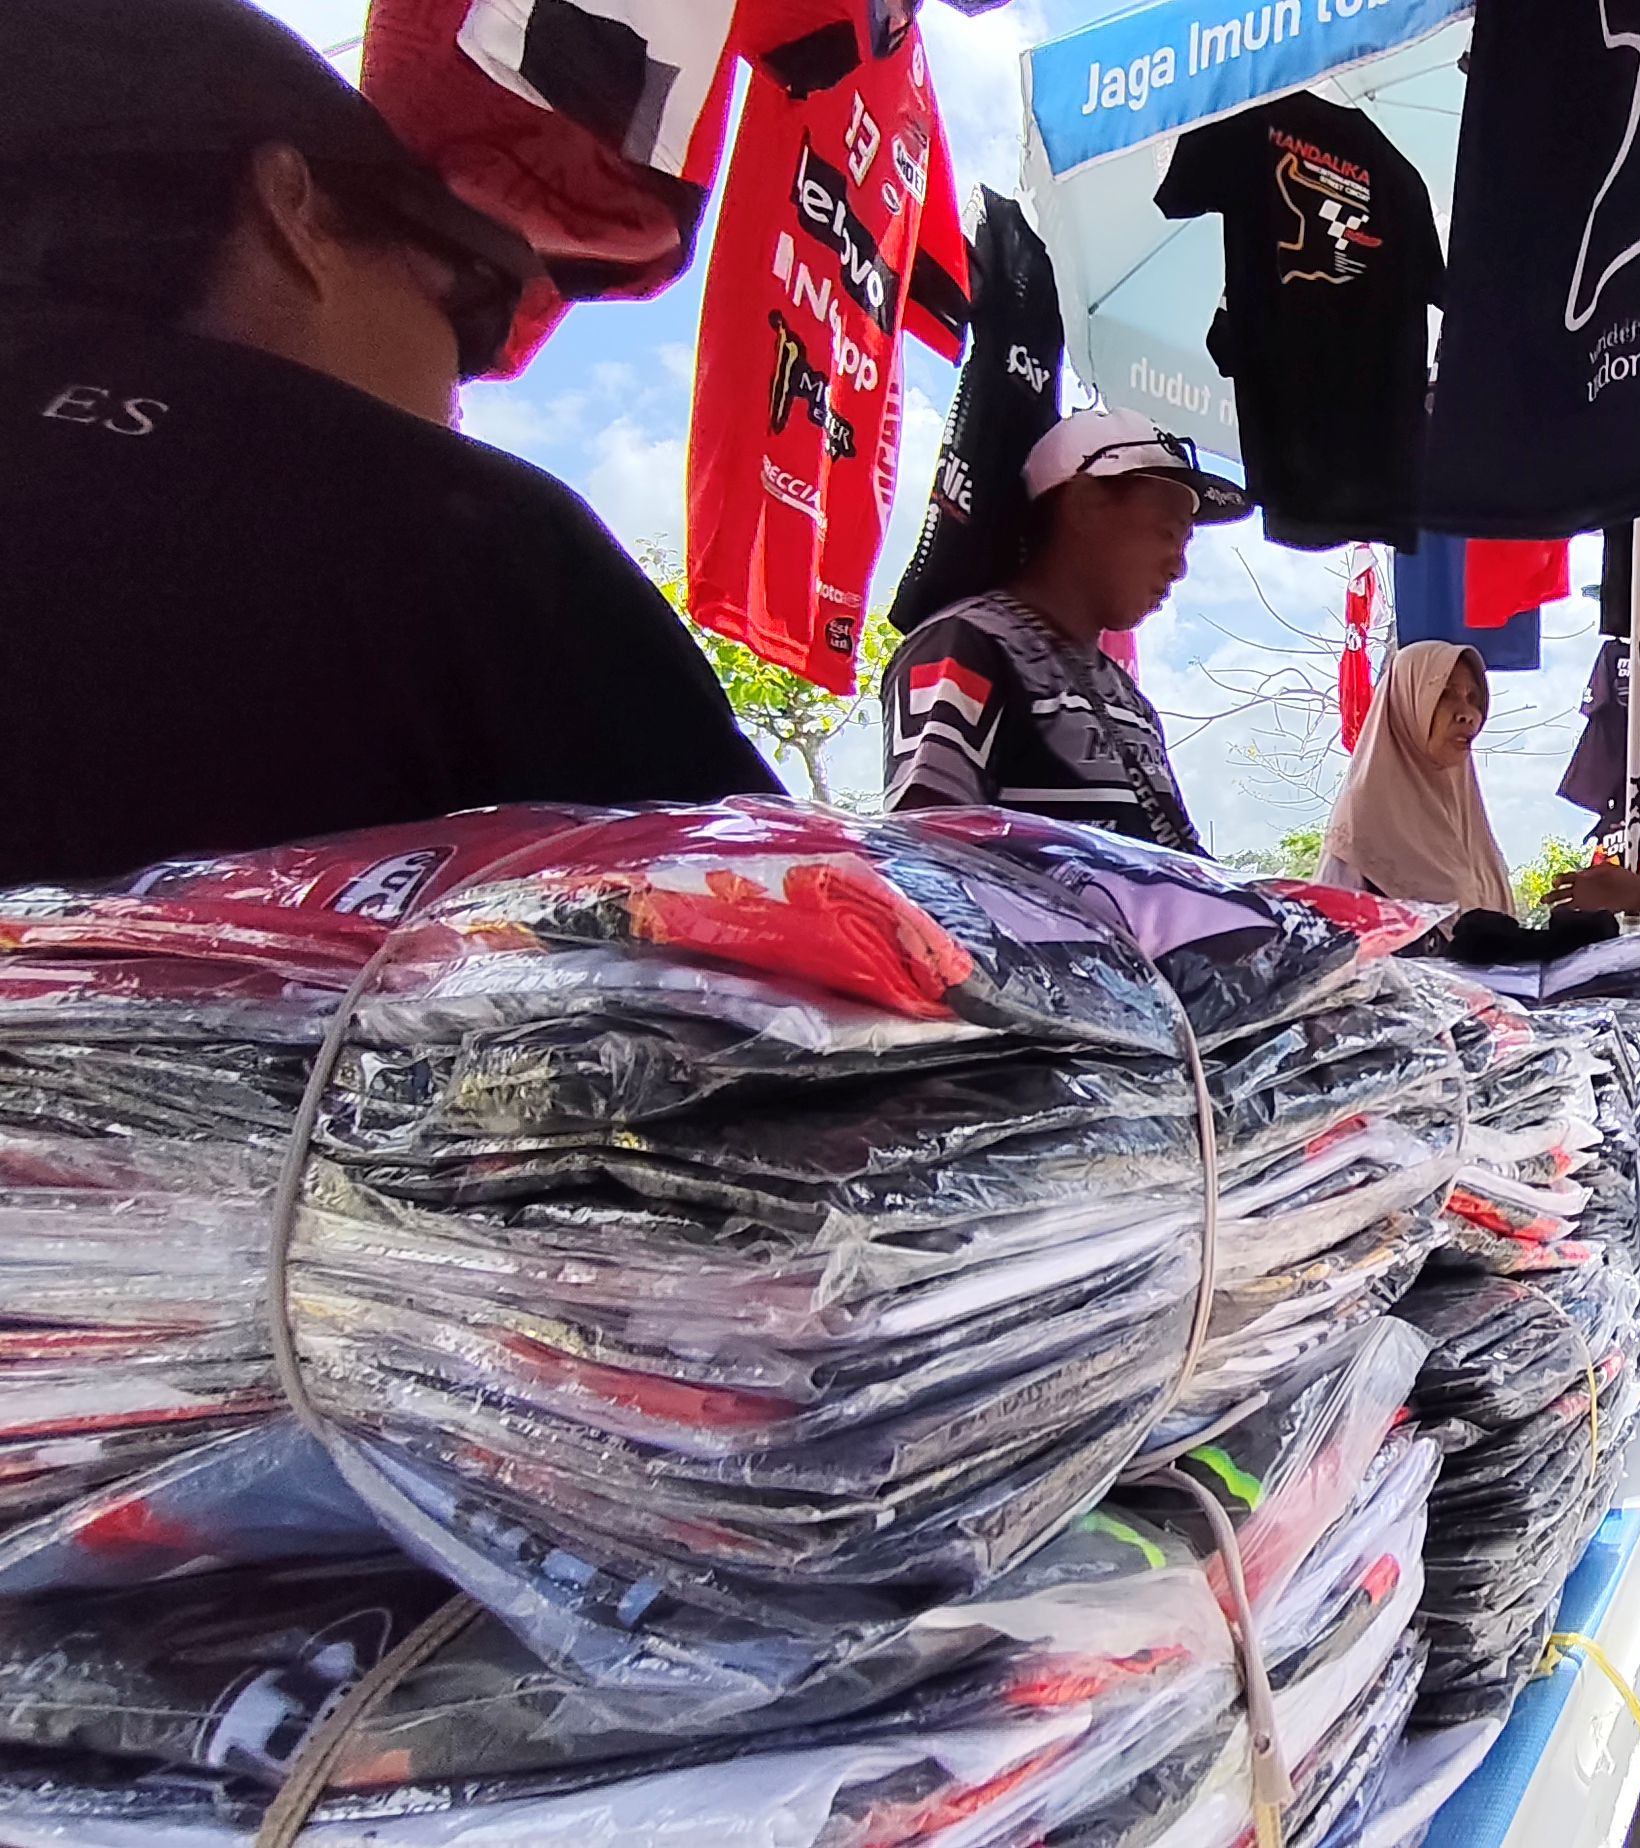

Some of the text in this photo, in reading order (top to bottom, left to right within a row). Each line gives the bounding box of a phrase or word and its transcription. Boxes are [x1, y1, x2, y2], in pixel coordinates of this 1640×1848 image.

[1081, 0, 1300, 116] Jaga Imun
[43, 384, 170, 436] ES
